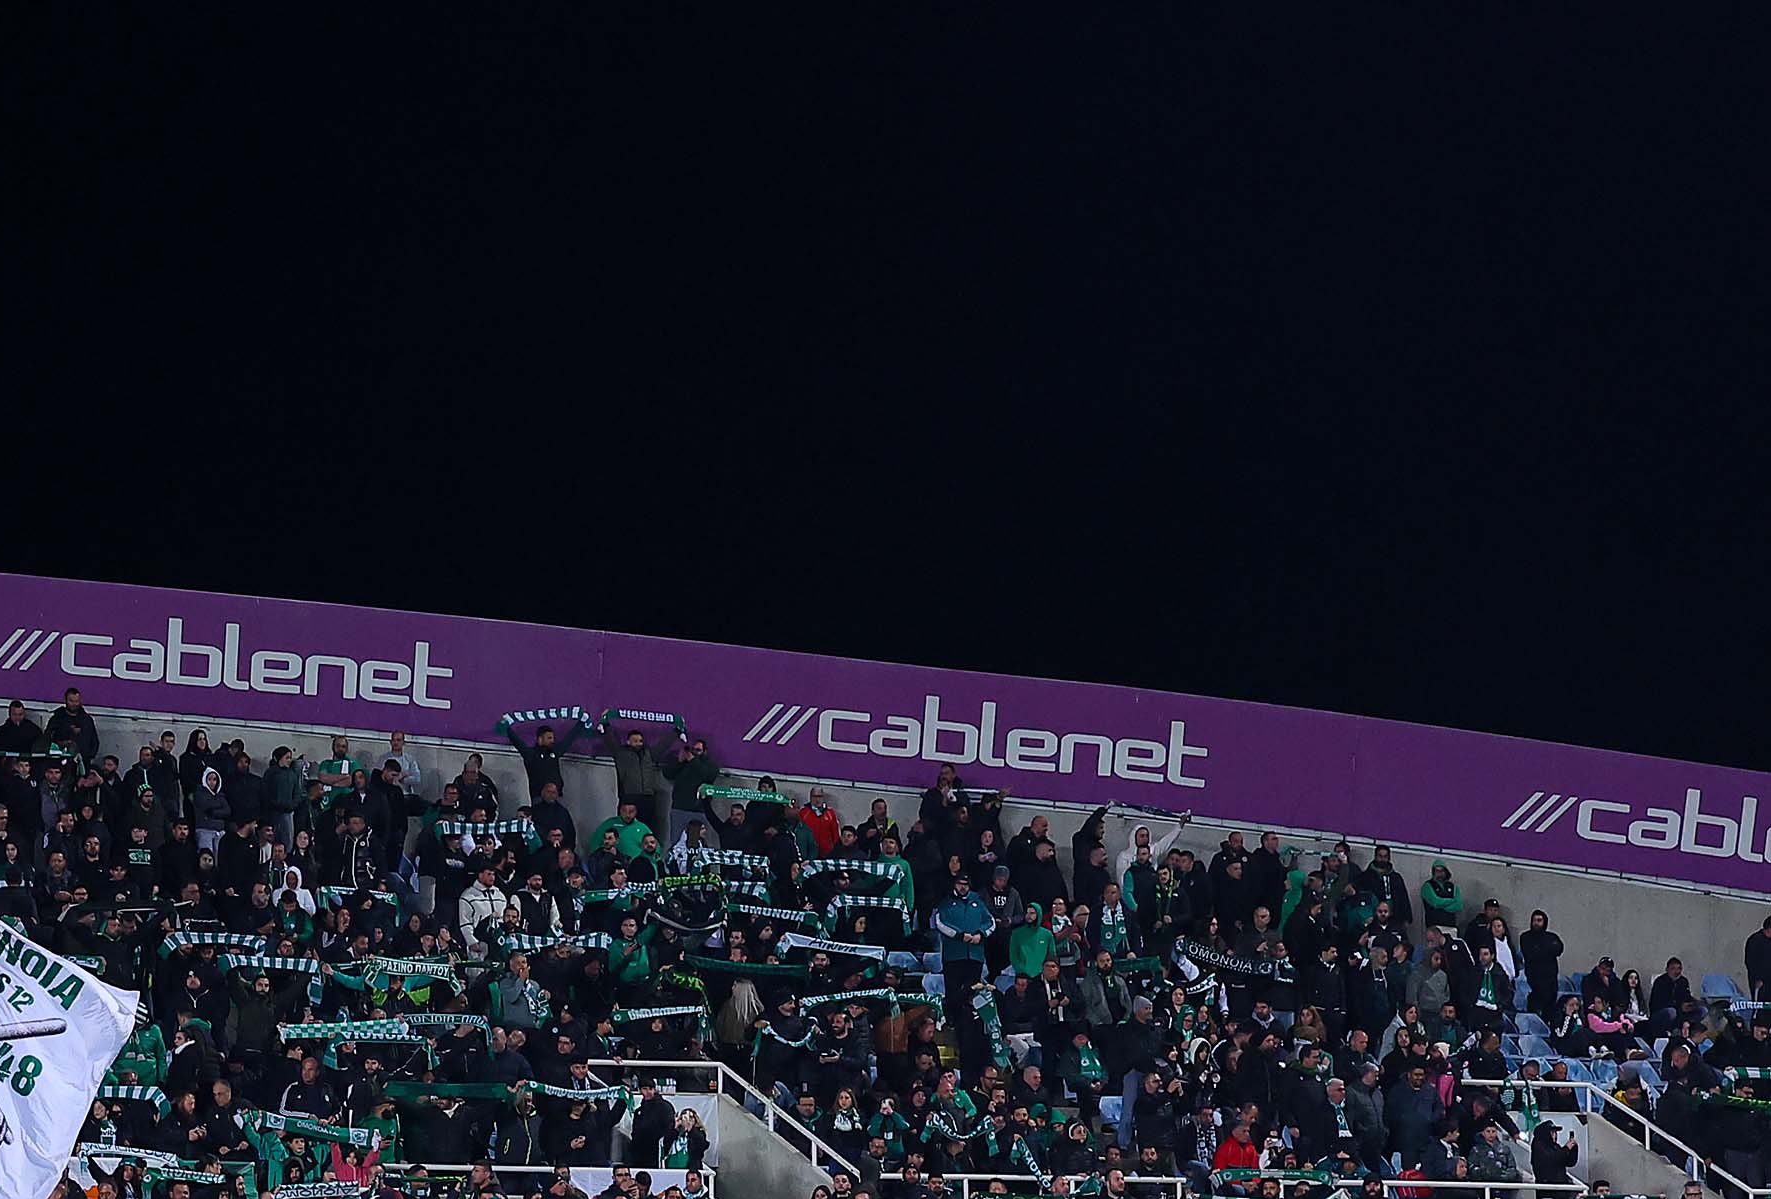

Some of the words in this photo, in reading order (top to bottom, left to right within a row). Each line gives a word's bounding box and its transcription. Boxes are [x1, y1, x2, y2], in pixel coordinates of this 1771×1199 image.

[61, 617, 453, 709] cablenet
[822, 696, 1207, 789] cablenet
[1577, 789, 1771, 864] cabl
[1187, 944, 1253, 972] OMONOIA
[8, 986, 35, 1013] 12
